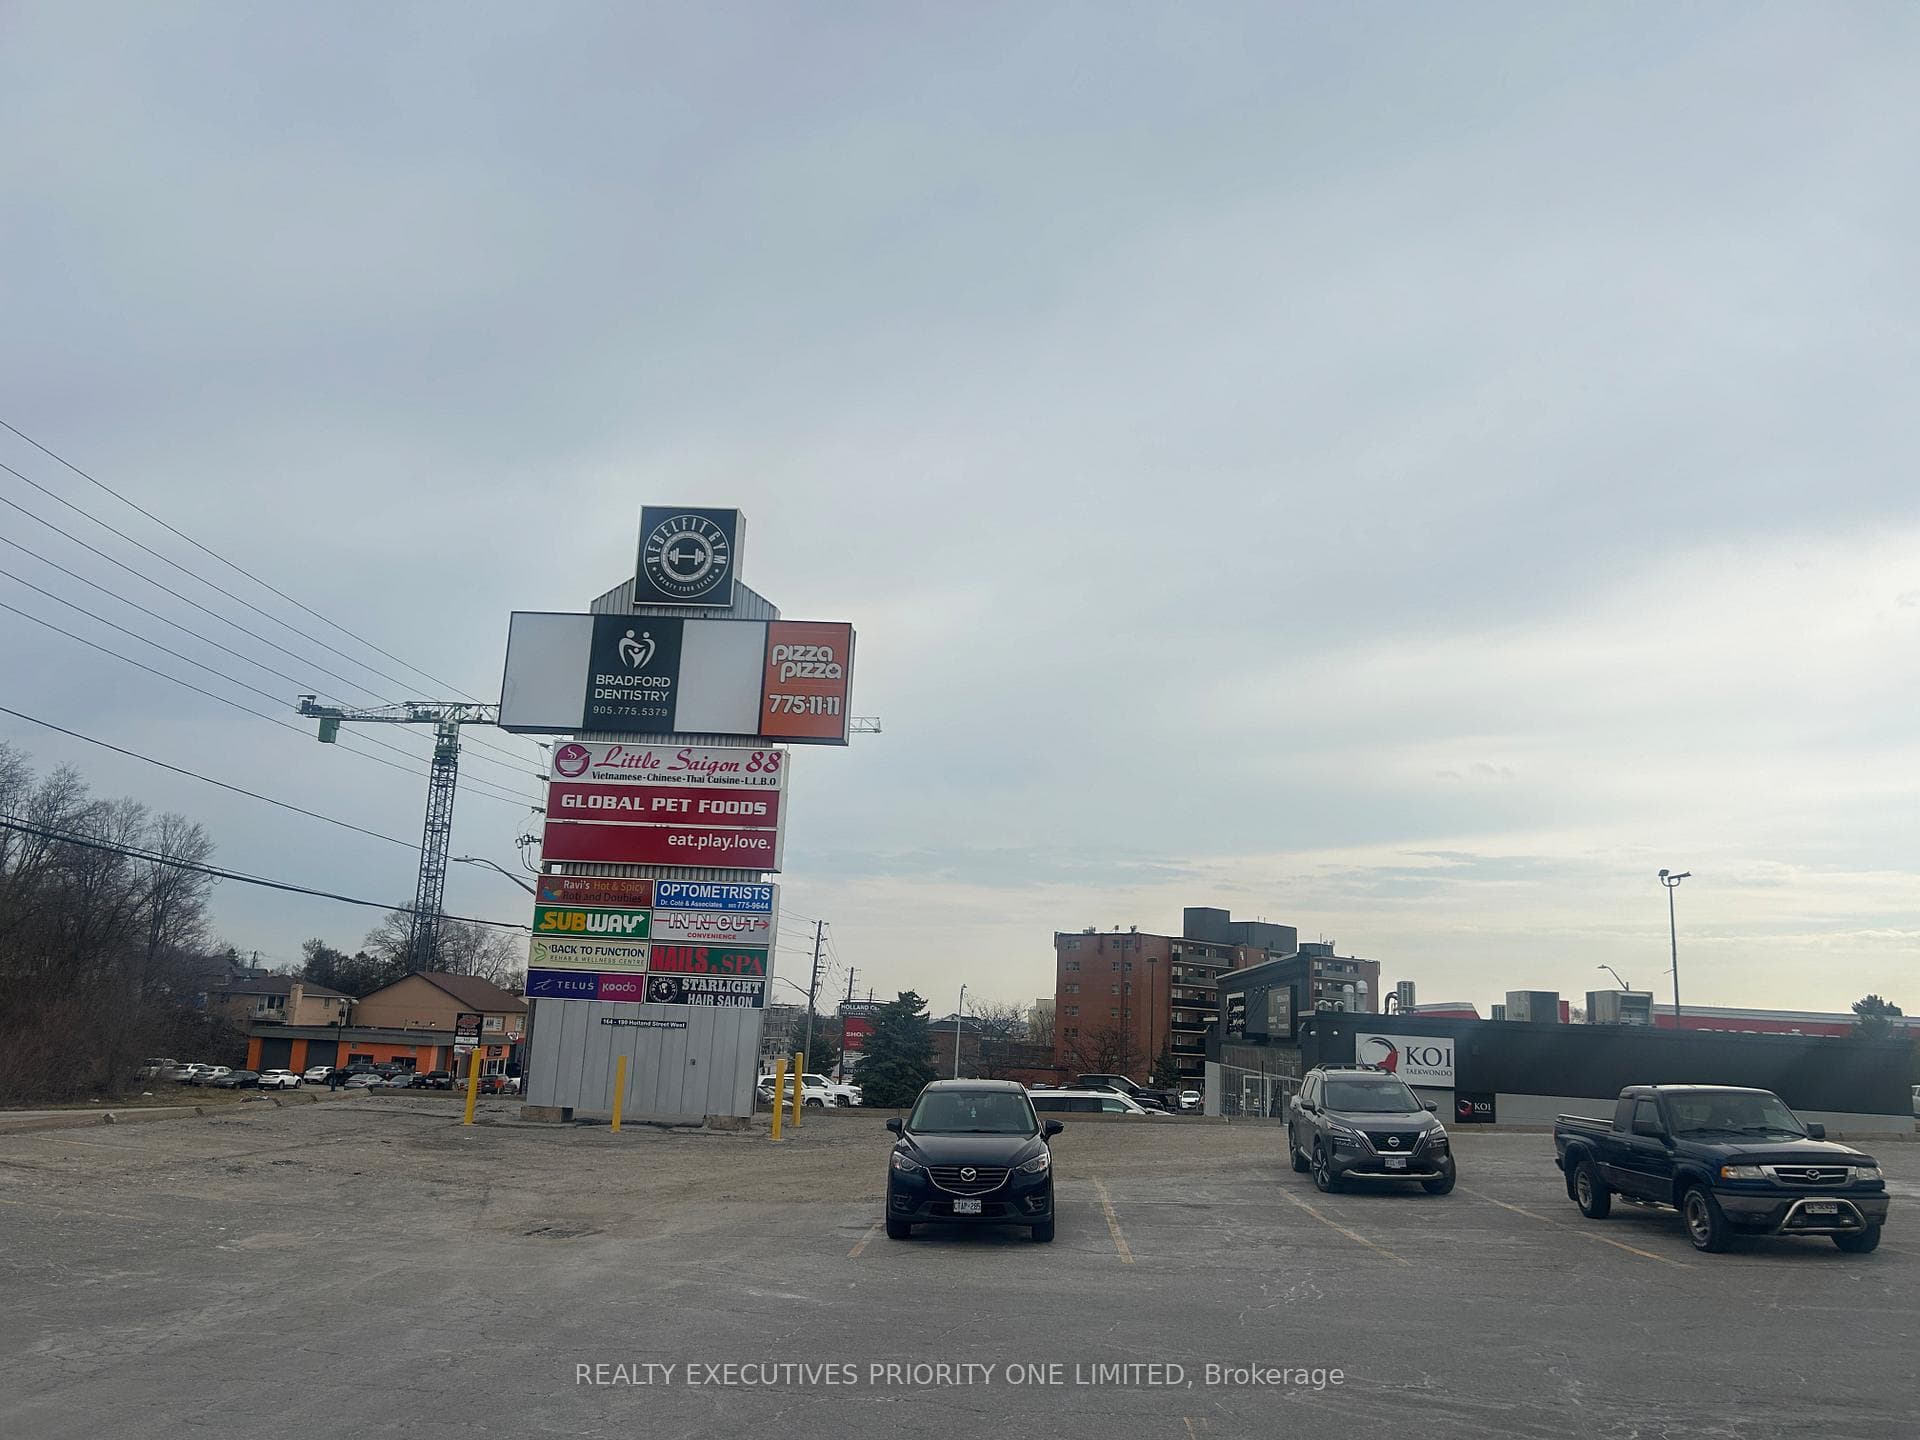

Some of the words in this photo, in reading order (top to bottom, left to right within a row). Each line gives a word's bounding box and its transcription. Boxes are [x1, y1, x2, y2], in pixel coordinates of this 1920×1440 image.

[646, 517, 709, 564] REBELFIT
[708, 531, 727, 565] GYM
[595, 674, 671, 688] BRADFORD
[594, 688, 670, 702] DENTISTRY
[592, 705, 668, 717] 905.775.5379
[593, 745, 661, 770] Little
[667, 748, 741, 775] Saigon
[745, 751, 782, 773] 88
[561, 794, 645, 811] GLOBAL
[651, 797, 692, 812] PET
[698, 799, 768, 816] FOODS
[667, 833, 771, 850] eat.play.love.
[563, 880, 590, 890] Ravi's
[593, 881, 609, 891] Hot
[611, 882, 619, 891] &
[620, 882, 646, 894] Spicy
[660, 883, 770, 901] OPTOMETRISTS
[583, 892, 601, 902] and
[690, 900, 723, 908] Associates
[539, 911, 645, 933] SUBWAY
[669, 913, 690, 929] IN
[695, 914, 711, 930] N
[716, 915, 759, 932] CUT
[687, 932, 737, 940] CONVENIENCE
[551, 944, 577, 954] BACK
[580, 946, 593, 955] TO
[595, 947, 645, 958] FUNCTION
[650, 945, 710, 973] NAILS
[720, 953, 763, 975] SPA
[557, 981, 595, 990] TELUS
[682, 977, 762, 994] STARLIGHT
[688, 993, 714, 1006] HAIR
[717, 995, 753, 1008] SALON
[1405, 1046, 1453, 1067] KOI
[1406, 1068, 1453, 1077] TAEKWONDO
[1474, 1102, 1492, 1111] KOI
